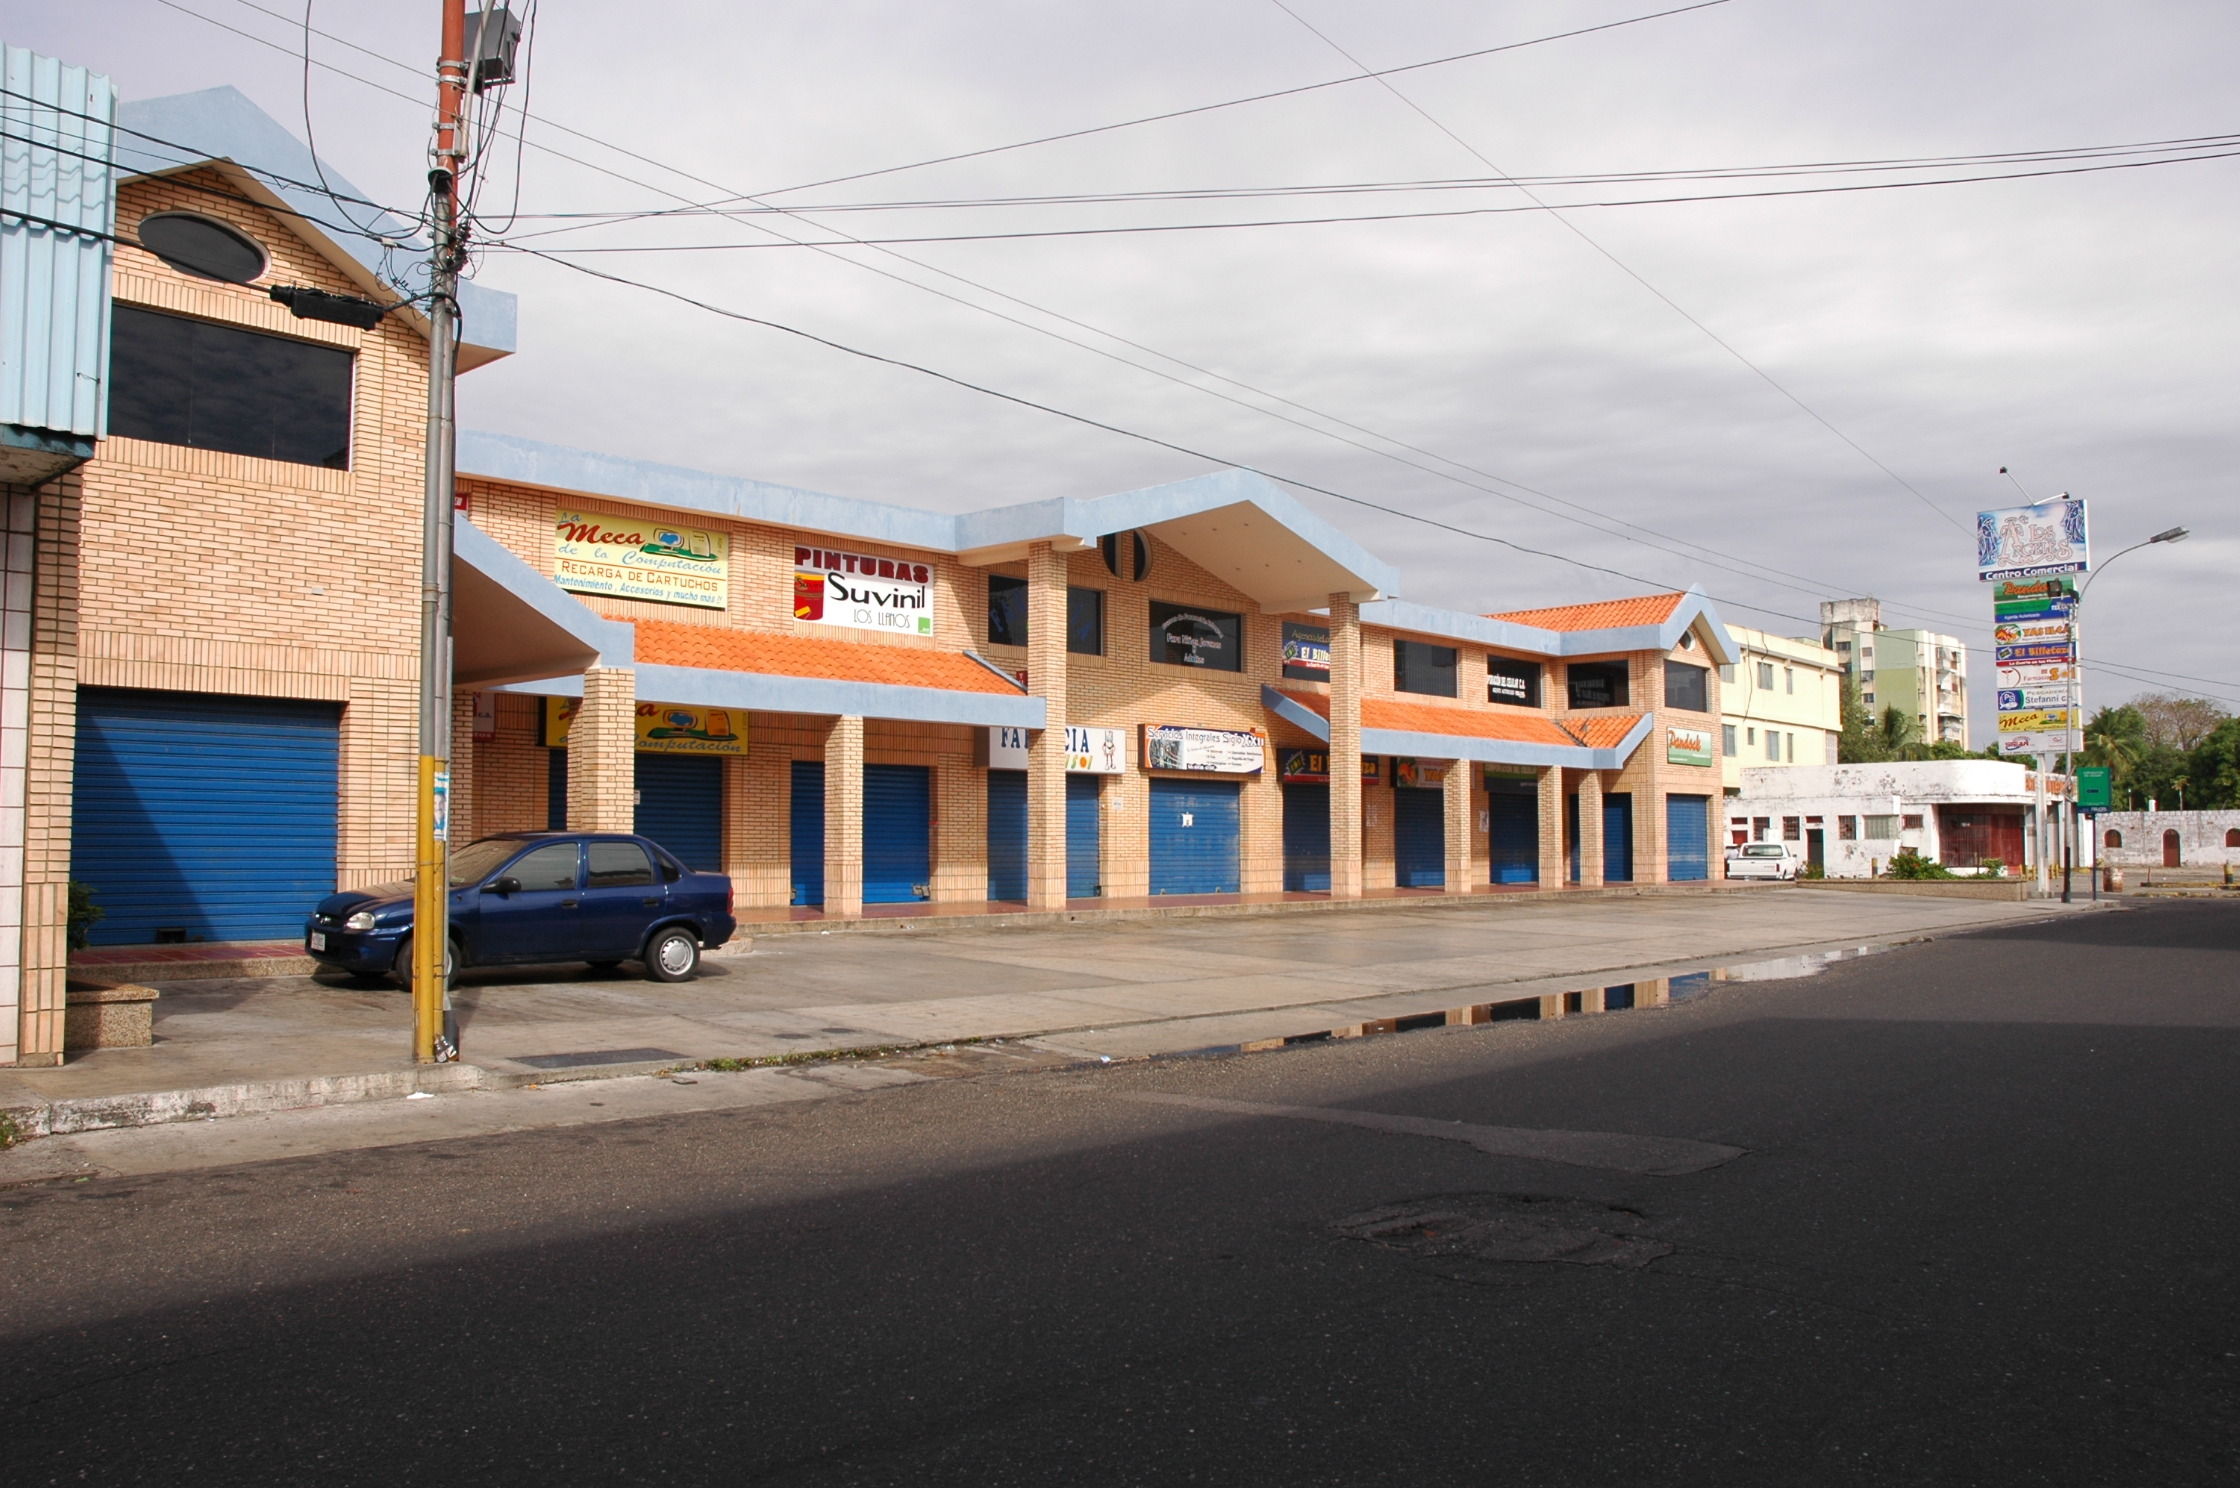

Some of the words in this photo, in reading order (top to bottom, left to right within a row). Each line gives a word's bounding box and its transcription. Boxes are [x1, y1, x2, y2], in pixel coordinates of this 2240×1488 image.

[558, 512, 582, 524] La
[557, 522, 646, 545] Meca
[558, 543, 578, 555] de
[594, 548, 609, 559] la
[622, 551, 722, 575] Computación
[794, 546, 929, 584] PINTURAS
[628, 570, 643, 583] DE
[646, 572, 718, 592] CARTUCHOS
[1985, 569, 2022, 581] Centro
[2023, 564, 2078, 577] Comercial
[620, 581, 664, 597] Accesorios
[666, 590, 672, 600] y
[673, 591, 698, 602] mucho
[827, 571, 926, 609] Suvinil
[853, 608, 873, 624] LOS
[1301, 646, 1310, 659] El
[2025, 694, 2059, 704] Stefanni
[1998, 713, 2039, 728] Meca
[1147, 727, 1184, 741] Servicios
[1185, 729, 1221, 744] Integrales
[1222, 732, 1241, 747] Siglo
[1309, 753, 1322, 772] El
